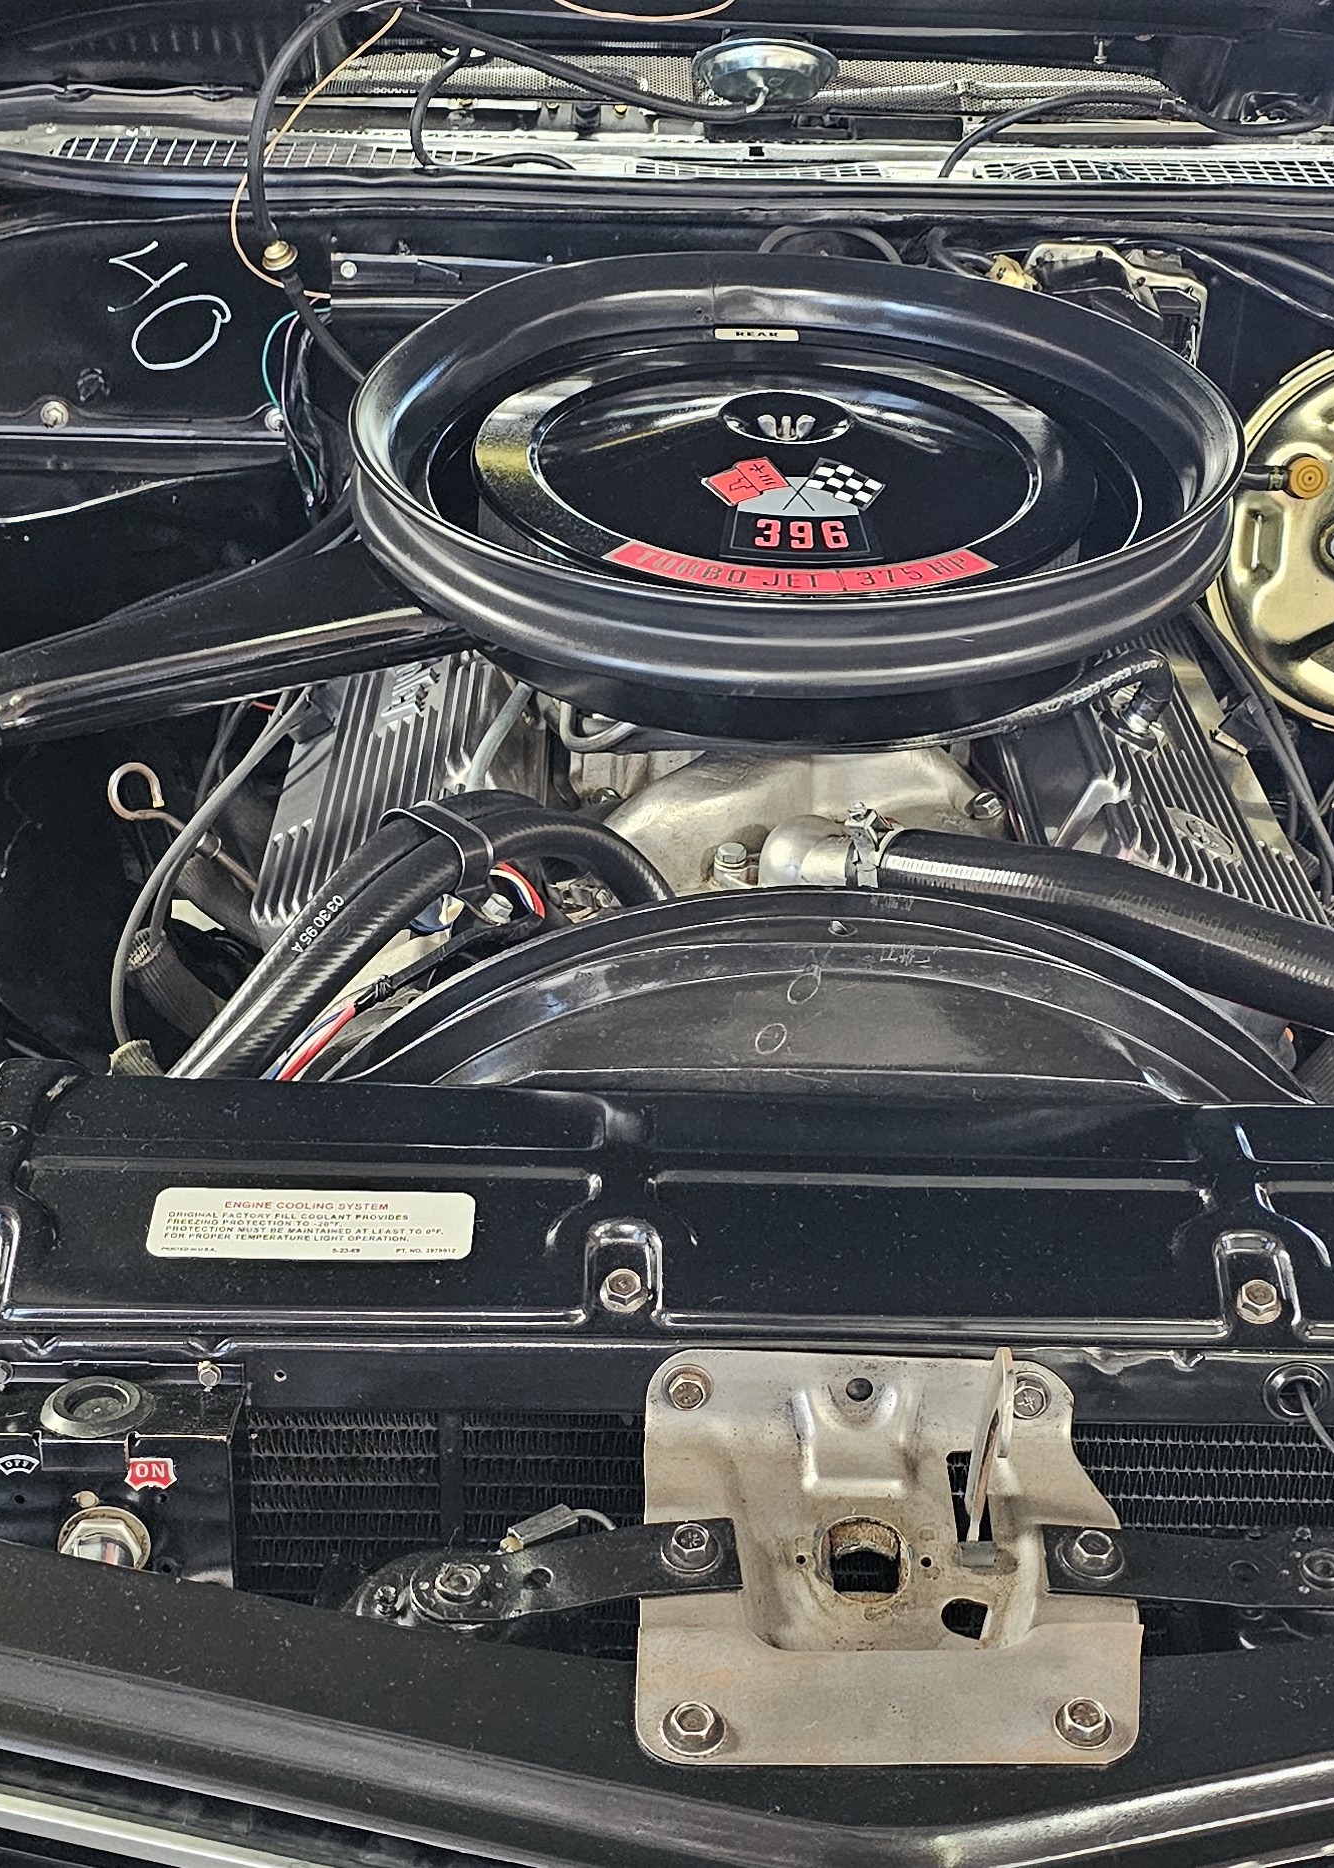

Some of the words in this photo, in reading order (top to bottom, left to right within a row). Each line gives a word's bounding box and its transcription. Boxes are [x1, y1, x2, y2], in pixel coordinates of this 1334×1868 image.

[108, 241, 231, 370] 40
[754, 518, 850, 550] 396
[856, 566, 923, 586] 375
[927, 554, 966, 576] HP
[326, 895, 345, 913] 03
[313, 909, 332, 928] 30
[224, 1201, 273, 1210] ENGINE
[276, 1202, 334, 1210] COOLING
[337, 1203, 389, 1211] SYSTEM
[135, 1463, 166, 1478] ON
